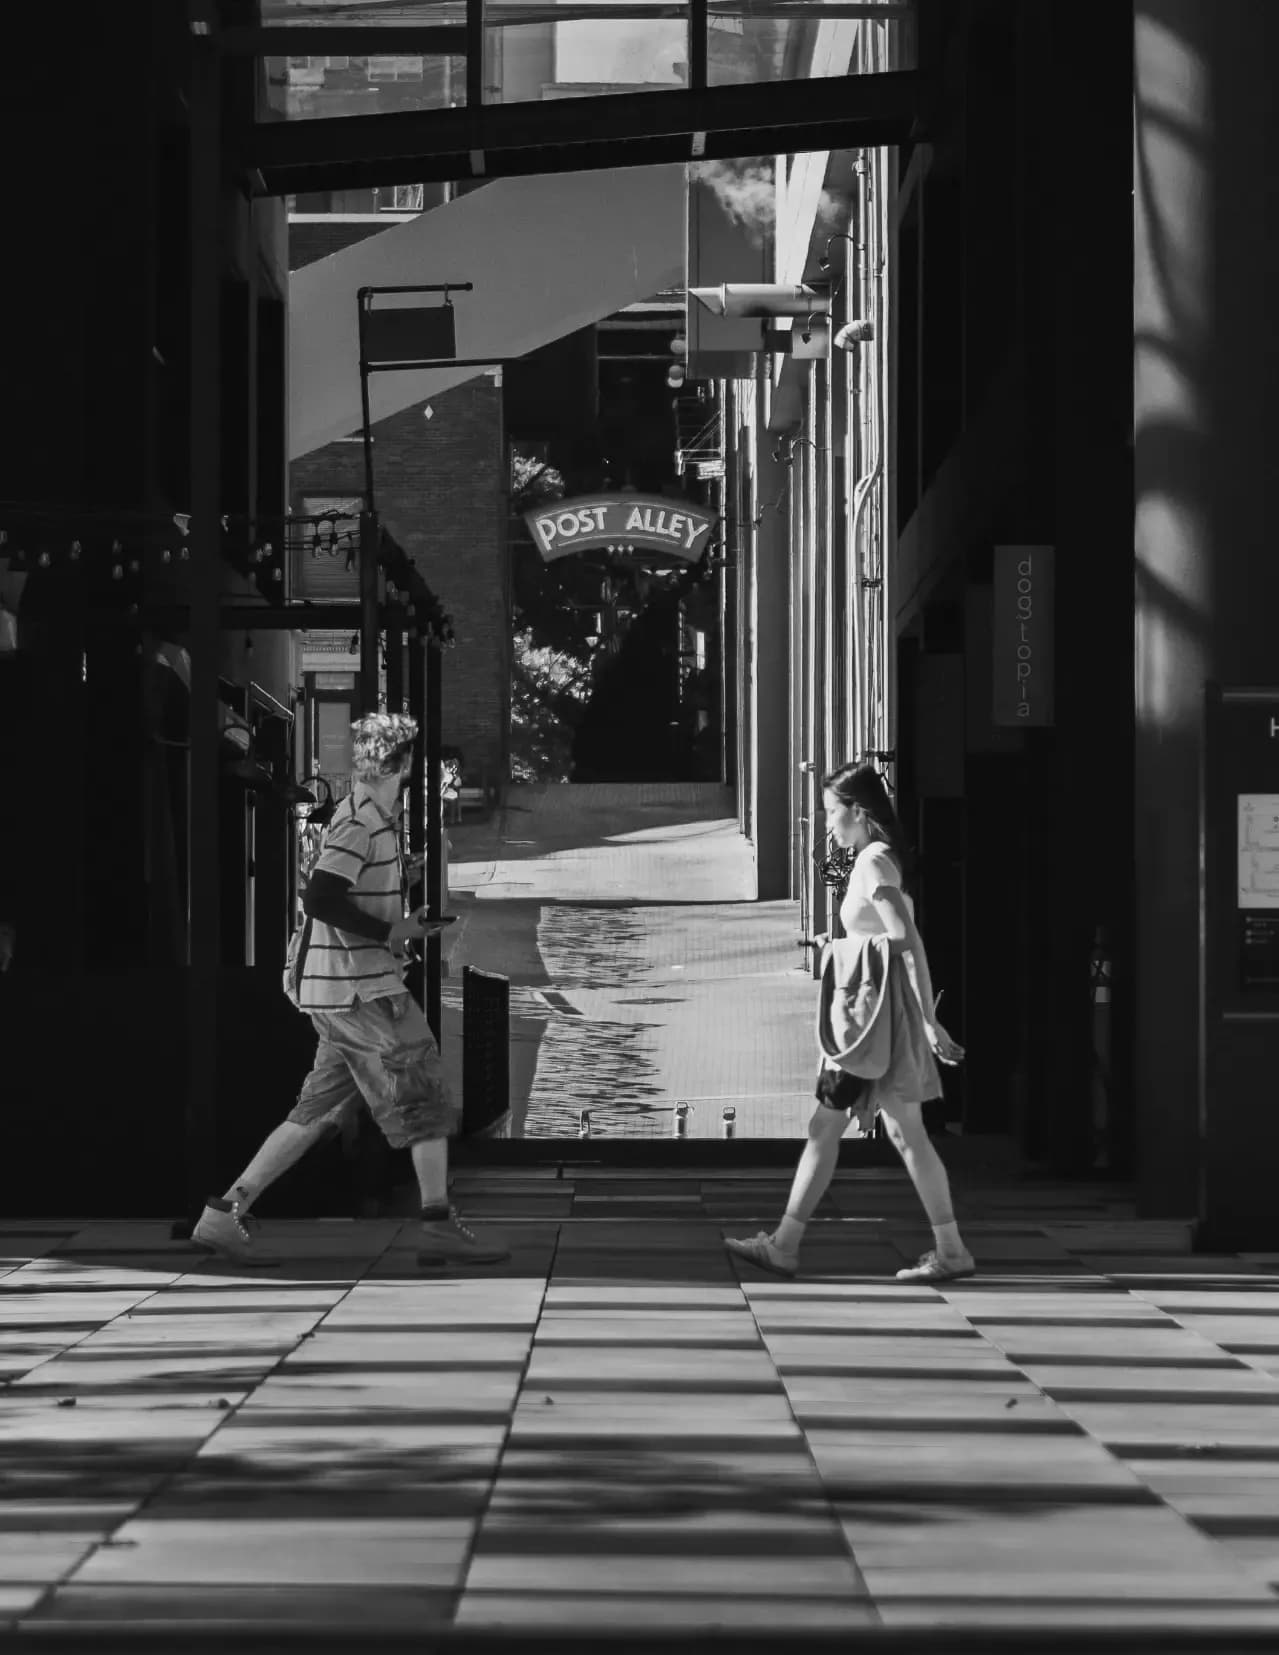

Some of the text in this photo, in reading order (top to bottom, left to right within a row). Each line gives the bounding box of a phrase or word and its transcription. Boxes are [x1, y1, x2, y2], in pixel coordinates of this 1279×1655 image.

[535, 507, 710, 551] POST ALLEY
[1016, 553, 1032, 717] dogtopia
